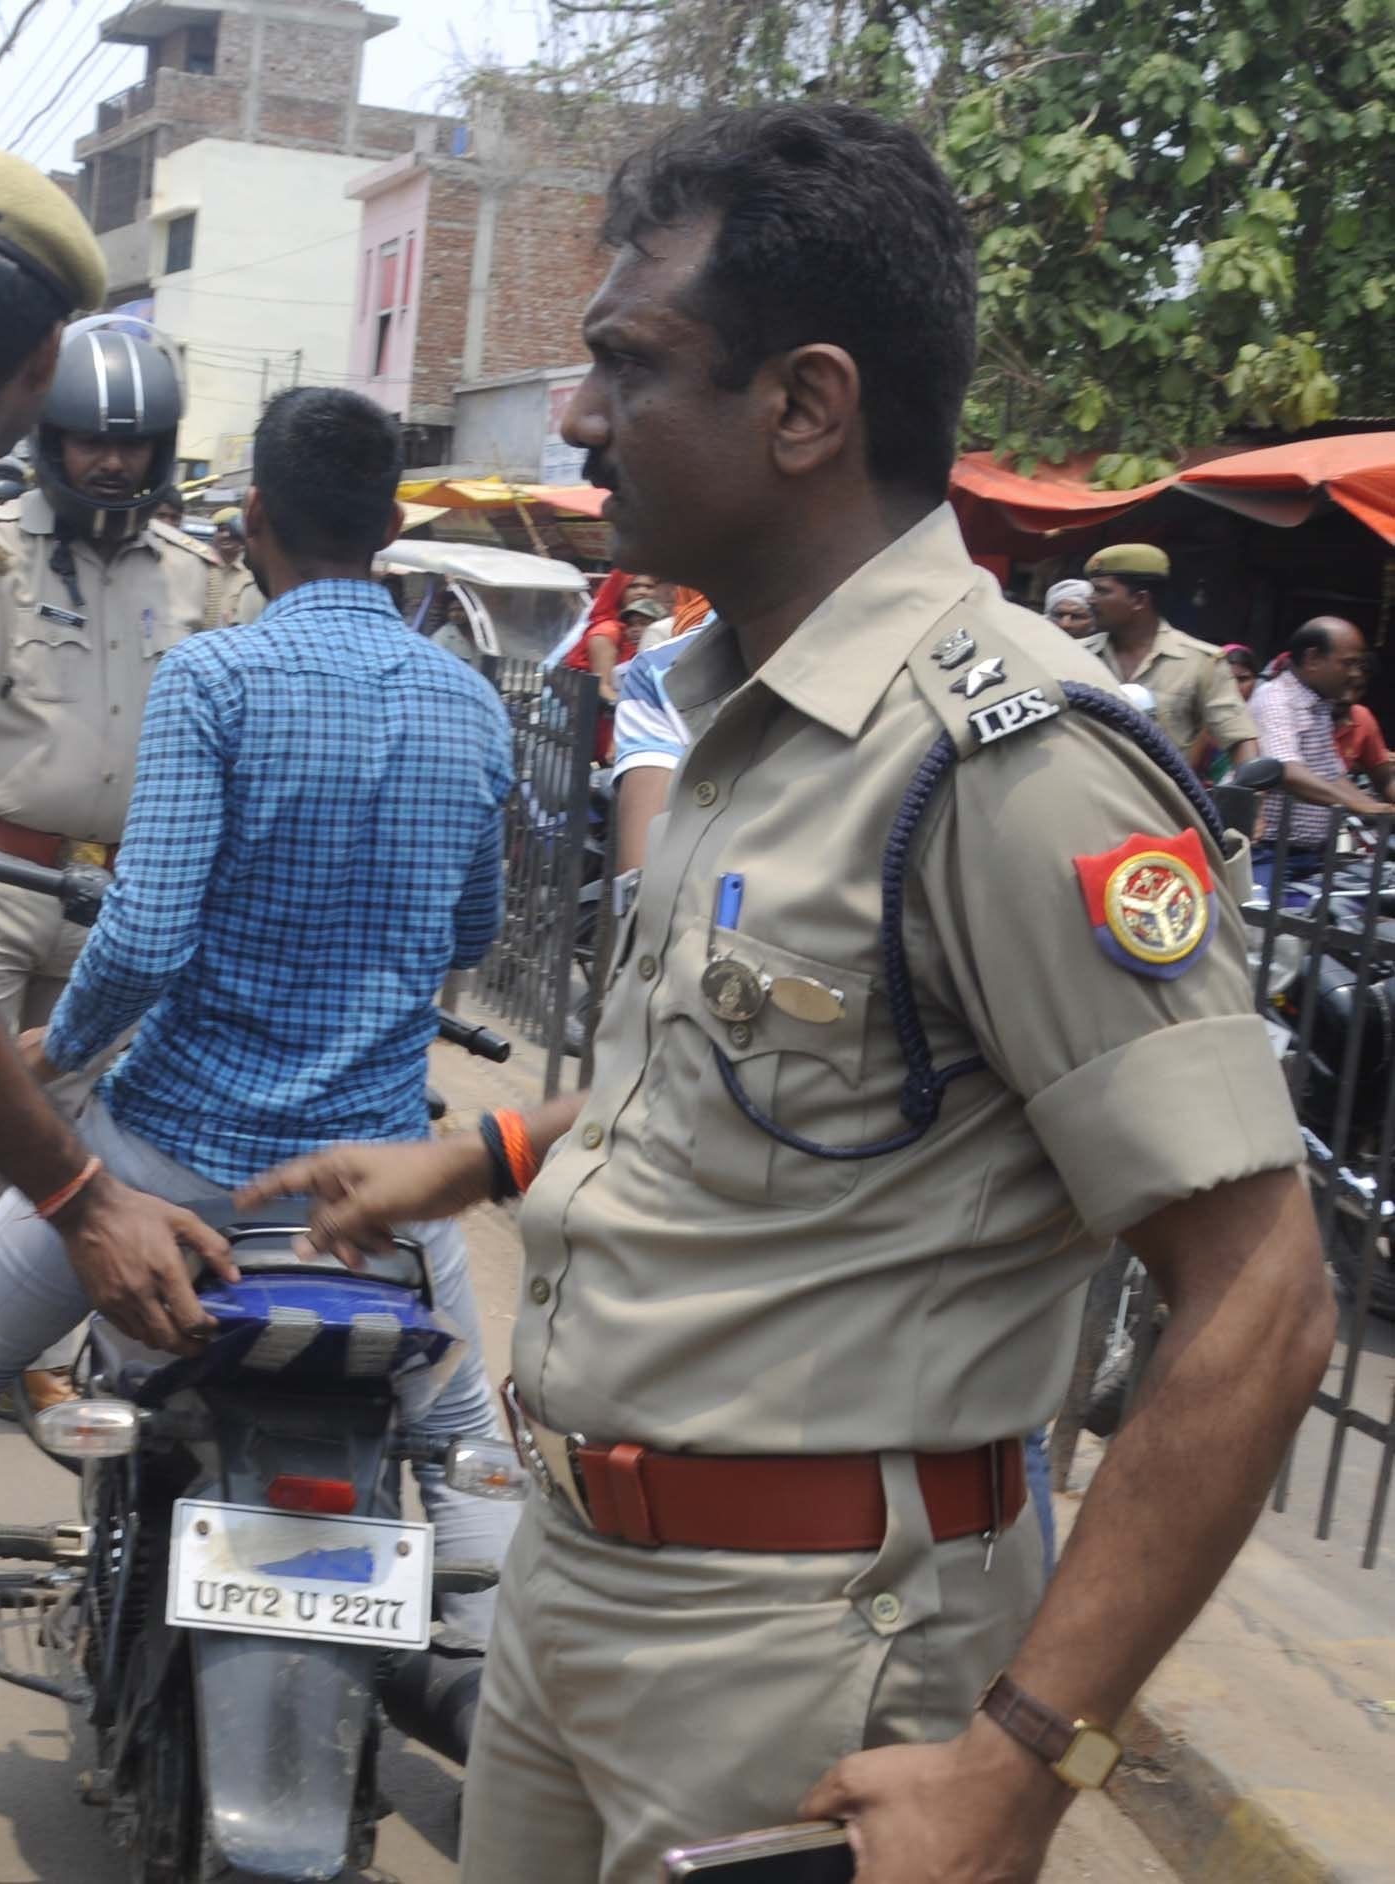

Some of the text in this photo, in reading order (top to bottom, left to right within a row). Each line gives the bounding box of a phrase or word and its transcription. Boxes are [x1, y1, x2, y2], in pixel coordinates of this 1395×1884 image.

[194, 1579, 407, 1630] UP72 U 2277
